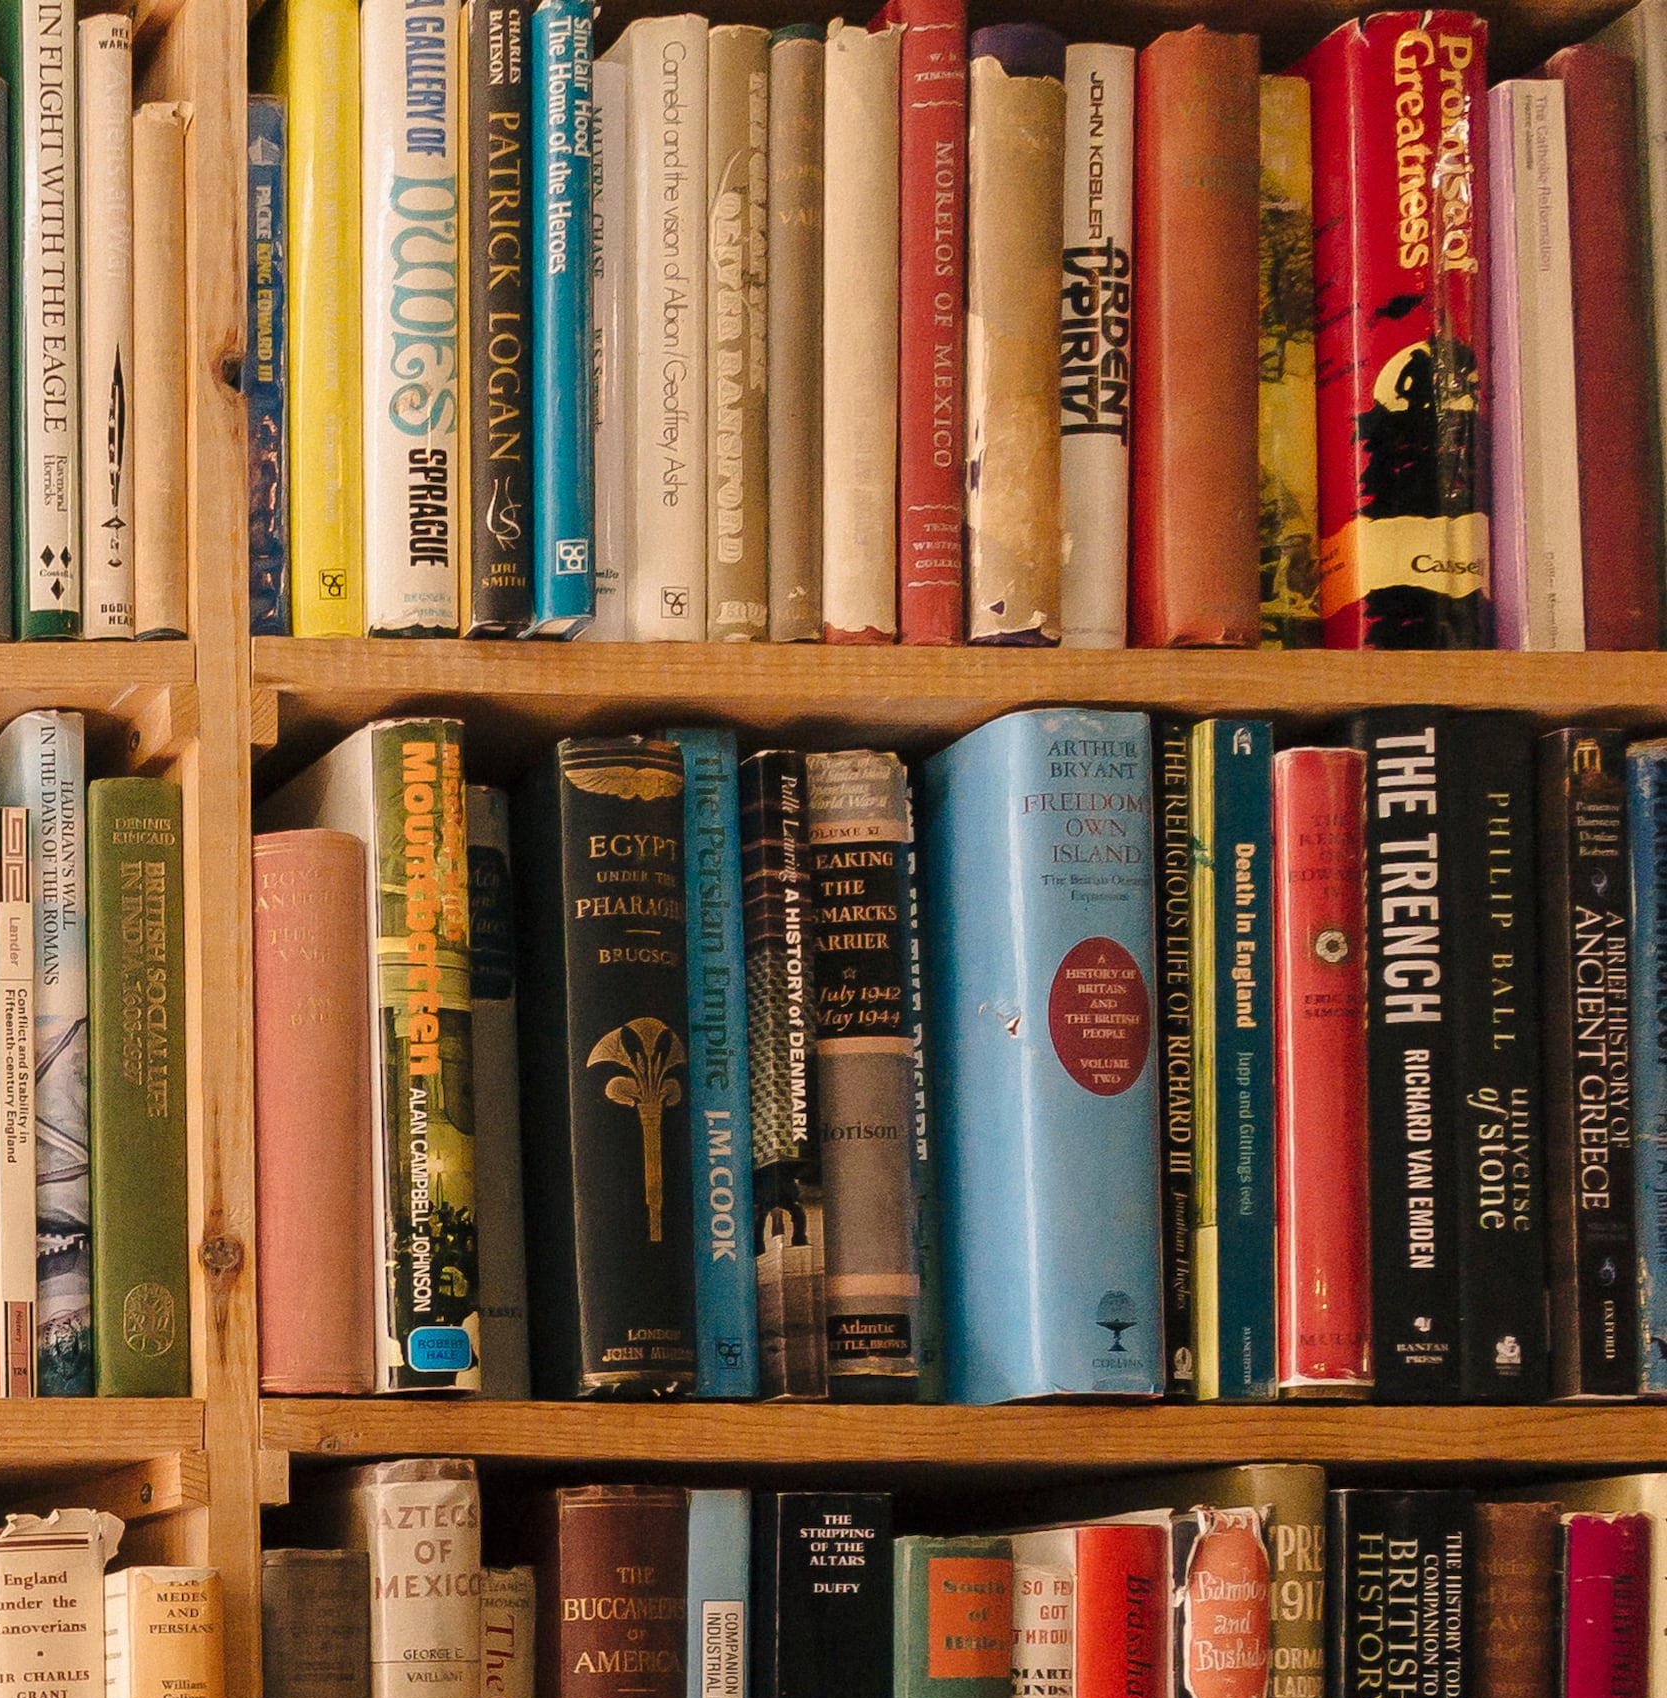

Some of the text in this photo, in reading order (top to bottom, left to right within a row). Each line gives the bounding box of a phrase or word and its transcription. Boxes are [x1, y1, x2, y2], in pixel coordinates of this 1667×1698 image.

[1089, 72, 1102, 240] JOHN KOBLER
[1394, 32, 1435, 269] Greatness
[487, 113, 522, 461] PATRICK LOGAN
[409, 448, 449, 569] SPRAGUE
[1377, 727, 1442, 1024] THE TRENCH
[1405, 1048, 1436, 1269] RICHARD VAN EMDEN
[409, 1087, 431, 1313] ALAN CAMPBELL-JOHNSON
[823, 1515, 852, 1526] THE
[800, 1527, 875, 1539] STRIPPING
[415, 1538, 453, 1564] OF
[810, 1541, 864, 1552] OF THE
[809, 1555, 866, 1567] ALTARS
[2, 1571, 68, 1589] England
[814, 1582, 860, 1594] DUFFY
[52, 1595, 77, 1609] the
[23, 1669, 90, 1683] CHARLES
